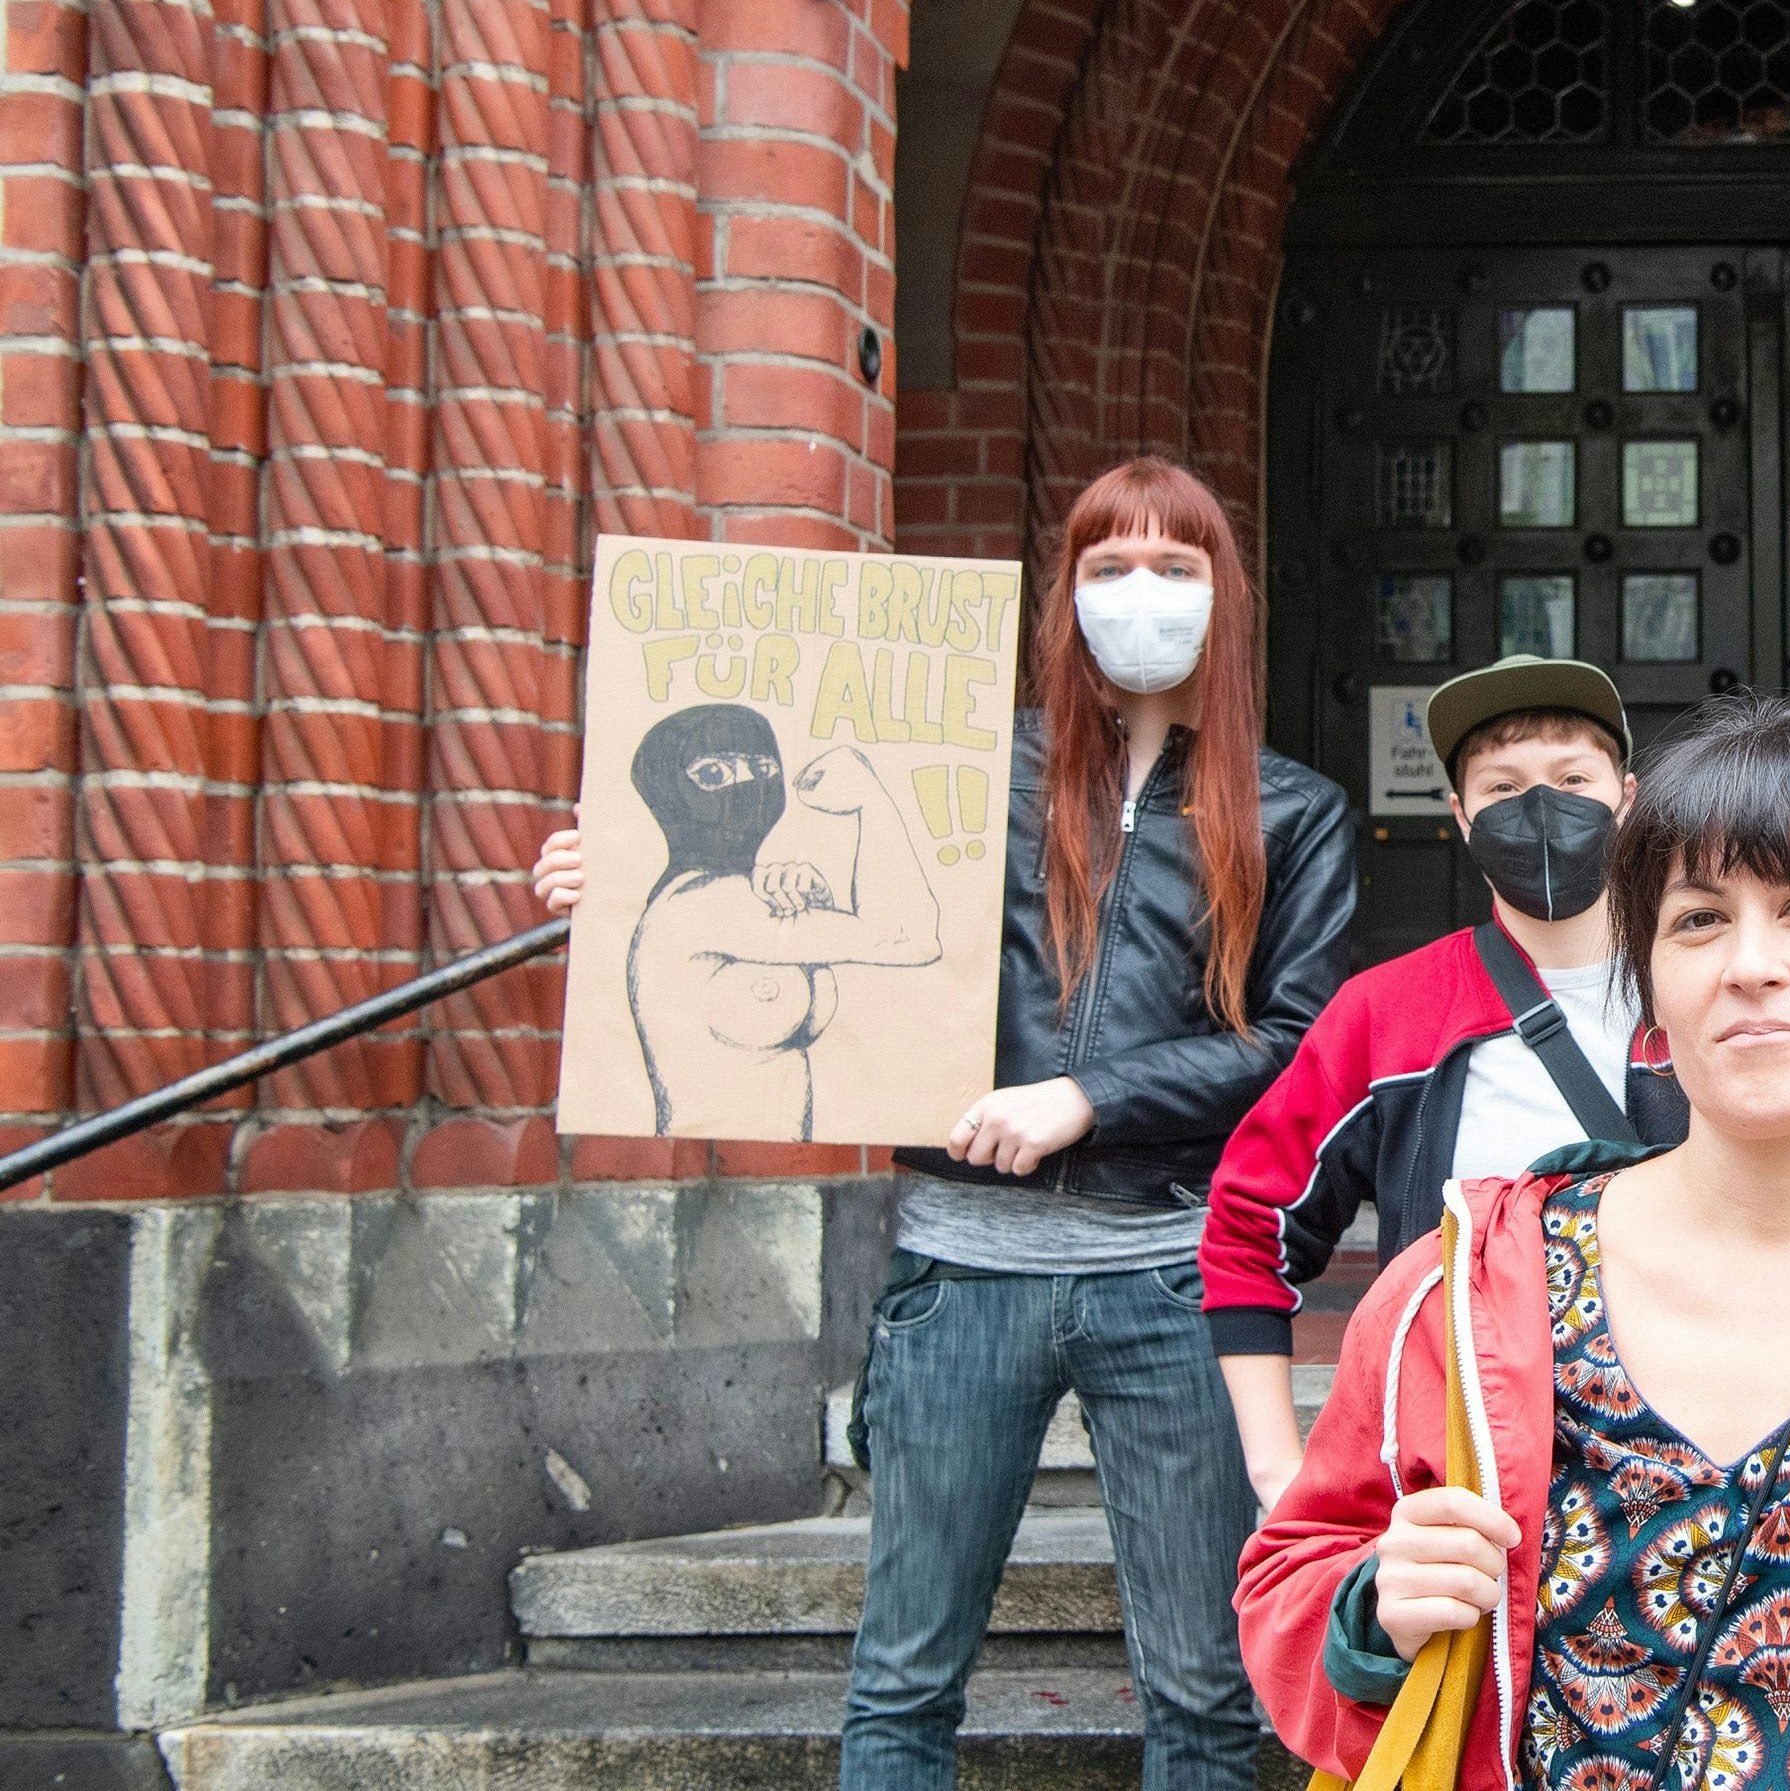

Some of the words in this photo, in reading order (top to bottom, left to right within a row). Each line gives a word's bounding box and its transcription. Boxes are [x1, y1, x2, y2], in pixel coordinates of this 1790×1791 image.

[857, 560, 1019, 652] BRUST
[641, 633, 801, 707] FÜR
[809, 640, 998, 751] ALLE
